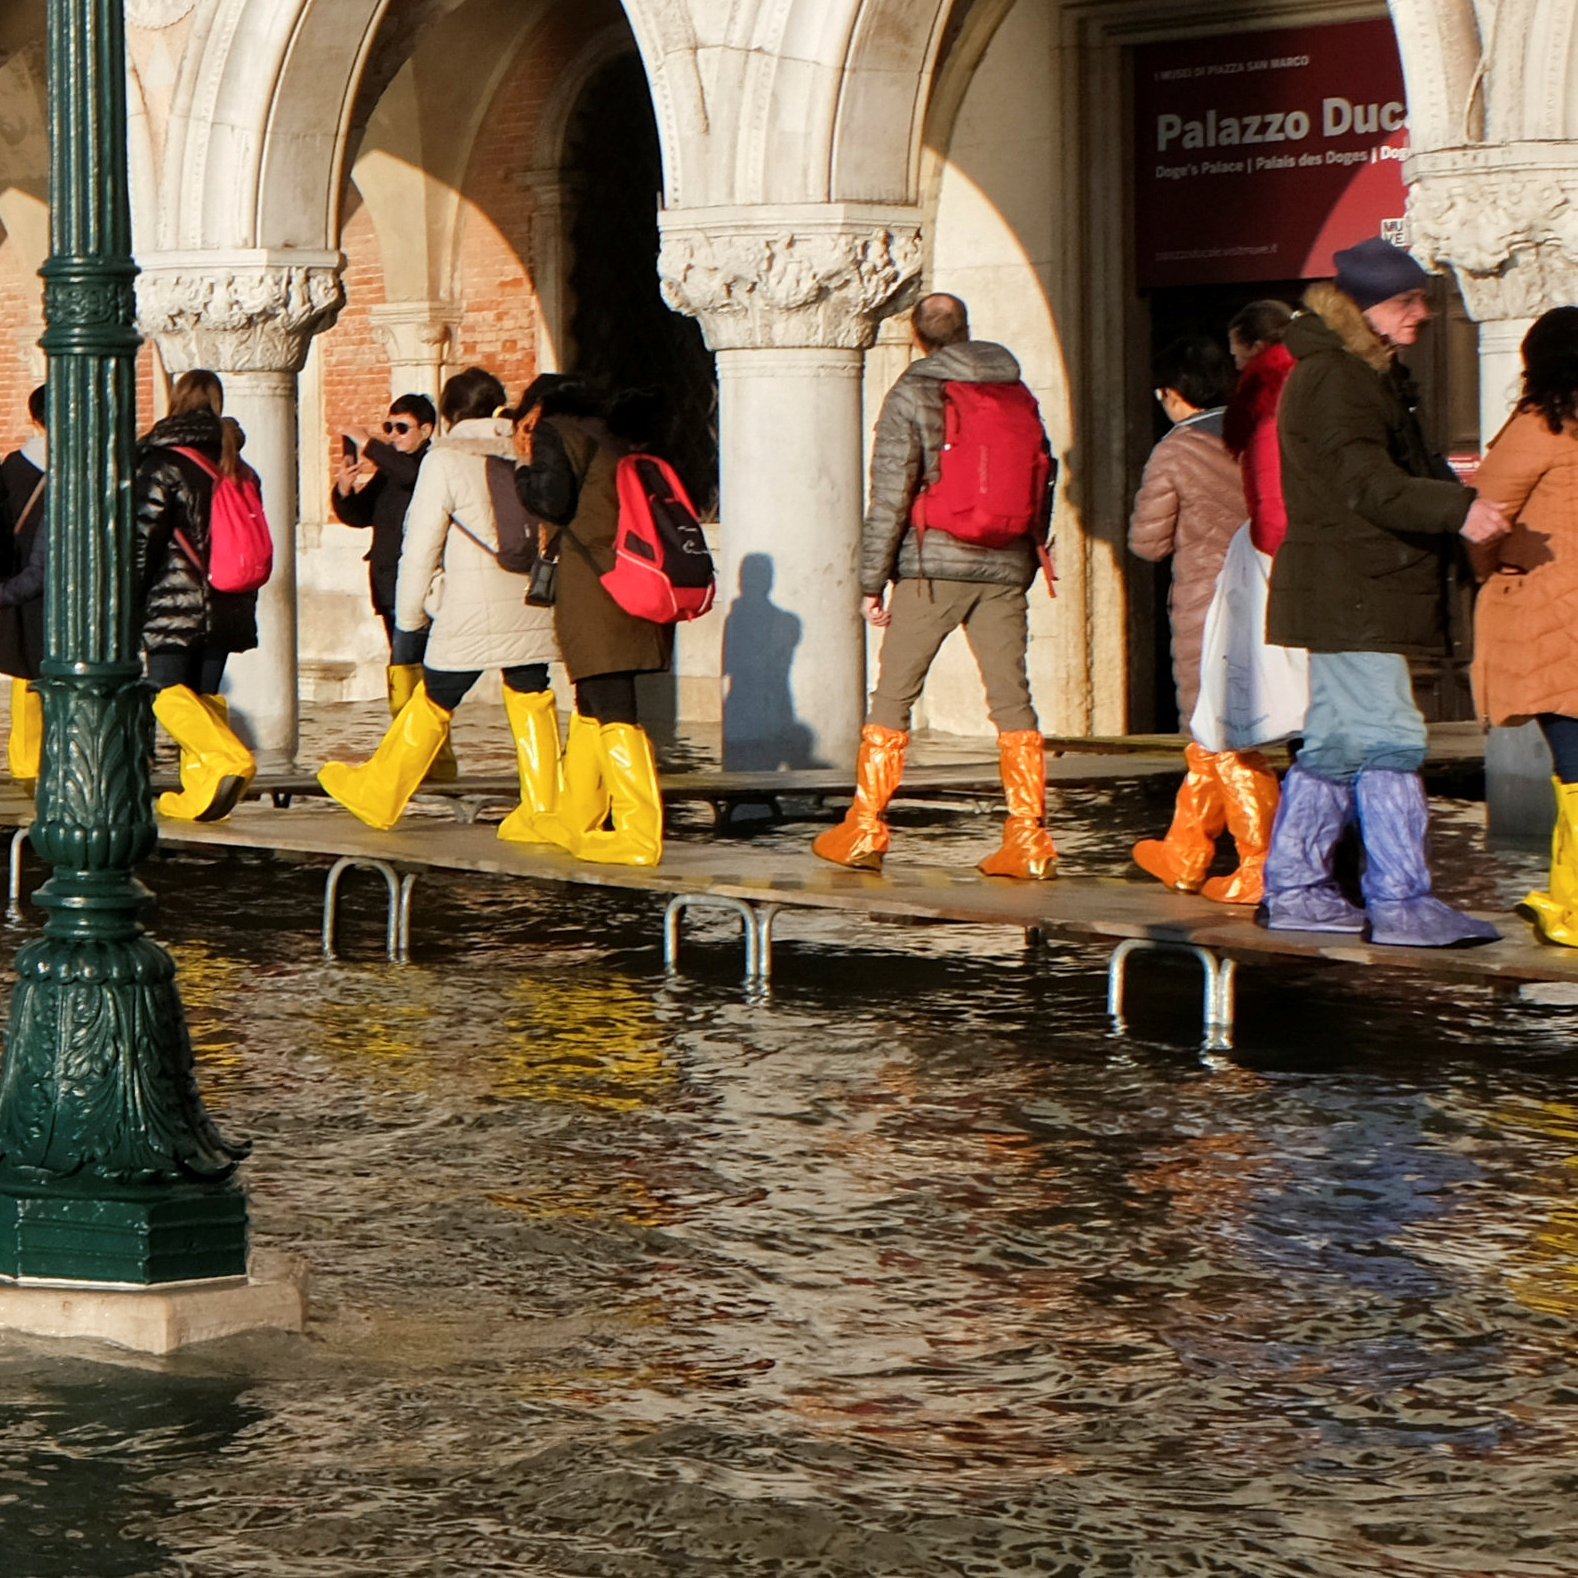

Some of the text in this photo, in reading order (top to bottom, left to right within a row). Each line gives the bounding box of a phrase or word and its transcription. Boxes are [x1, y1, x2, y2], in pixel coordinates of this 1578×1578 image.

[1207, 62, 1245, 76] PIAZZA
[1246, 59, 1268, 72] SAN
[1270, 54, 1310, 70] MARCO
[1157, 97, 1409, 151] Palazzo Duc
[1155, 163, 1198, 180] Doge's
[1201, 159, 1244, 174] Palace
[1256, 155, 1296, 170] Palais
[1298, 152, 1322, 166] des
[1325, 150, 1368, 165] Doges
